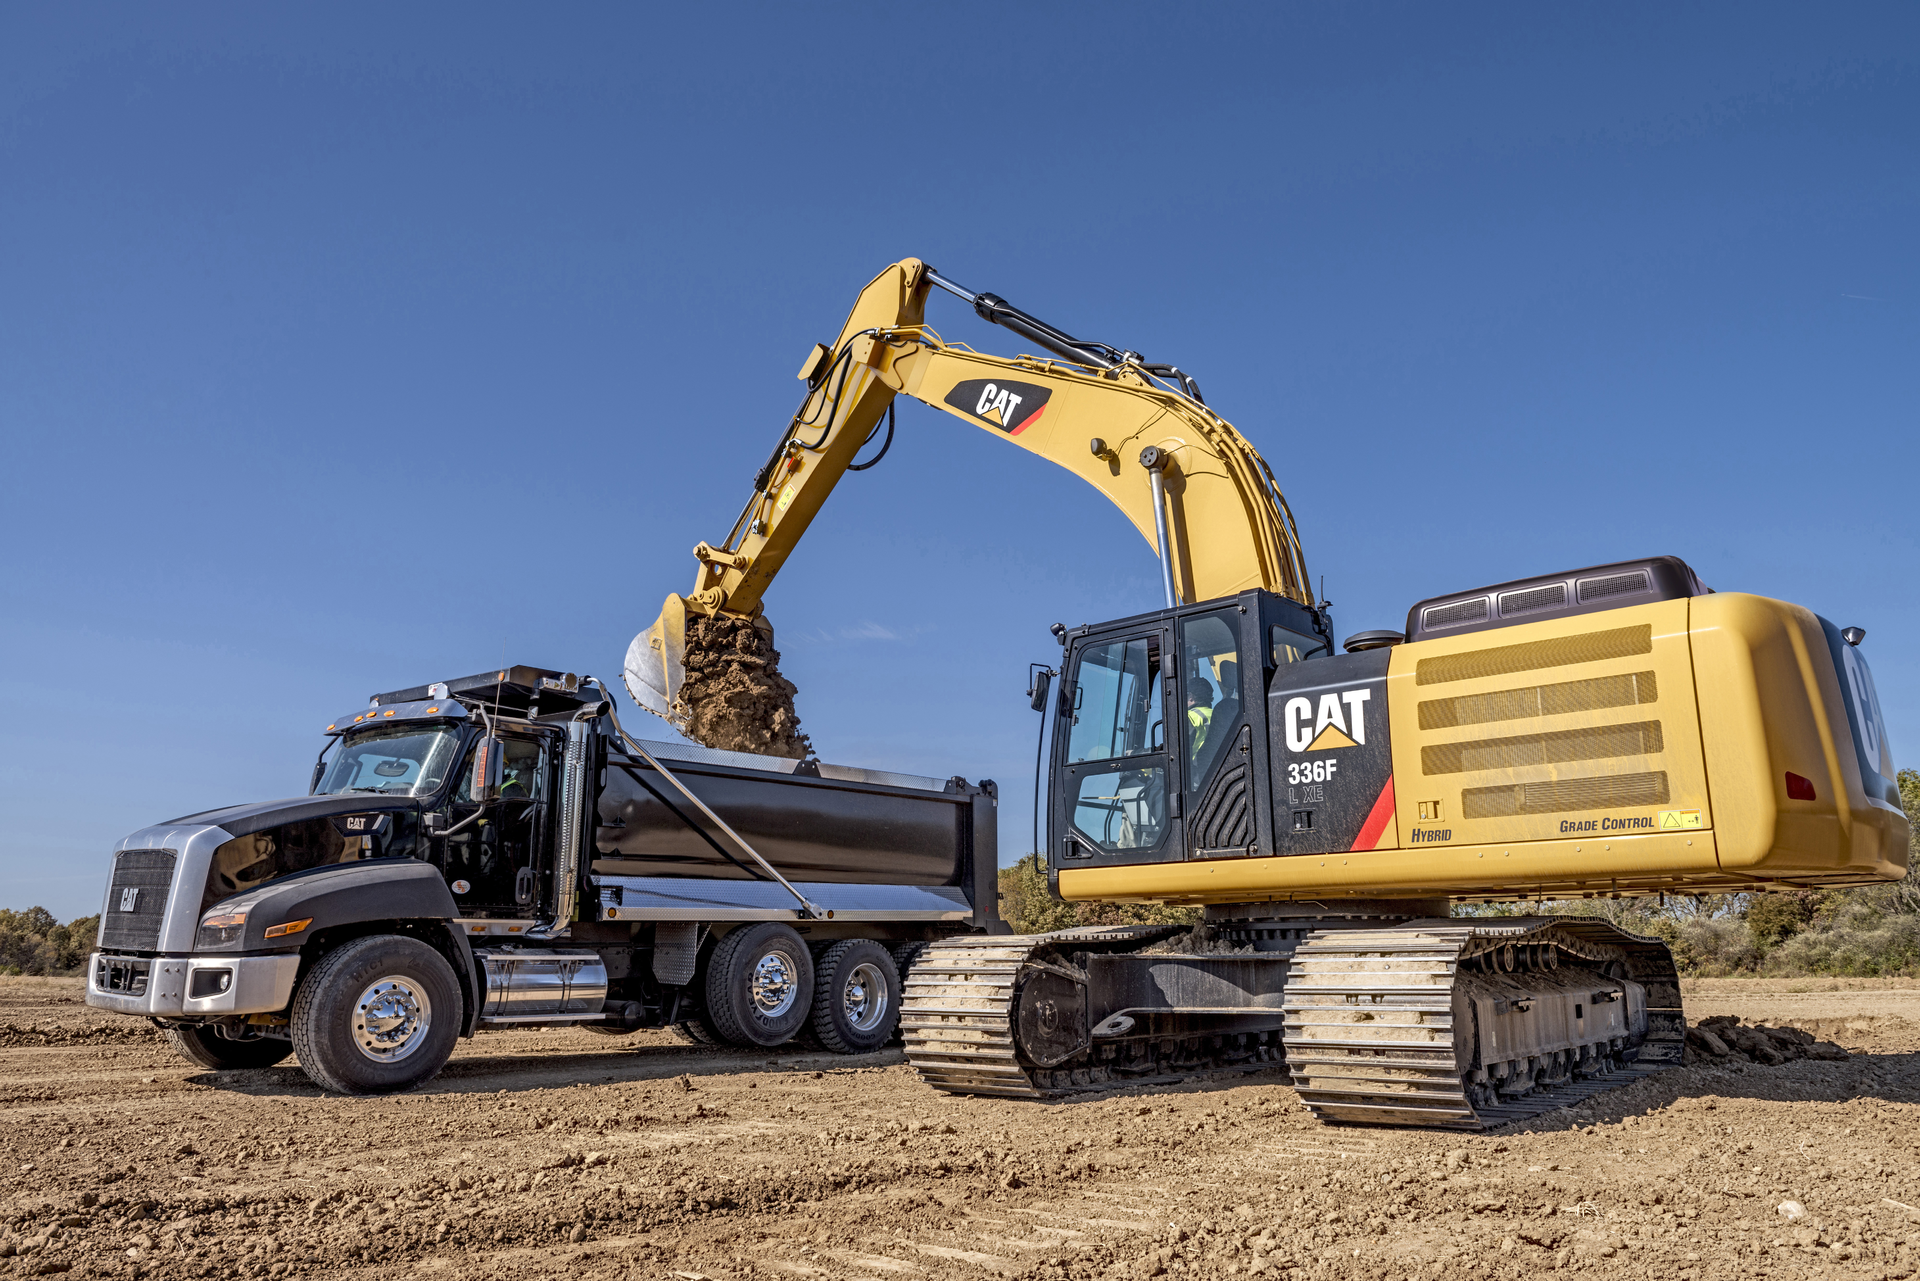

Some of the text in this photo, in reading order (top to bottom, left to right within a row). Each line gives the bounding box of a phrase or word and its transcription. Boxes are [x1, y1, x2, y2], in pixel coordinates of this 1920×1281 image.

[975, 383, 1023, 427] CAT
[1284, 688, 1371, 753] CAT
[1842, 644, 1890, 775] CA
[1287, 759, 1337, 785] 336F
[1288, 785, 1324, 805] L XE
[346, 816, 366, 830] CAT
[1411, 828, 1452, 843] HYBRID
[1559, 817, 1655, 833] GRADE CONTROL
[120, 887, 140, 912] CAT
